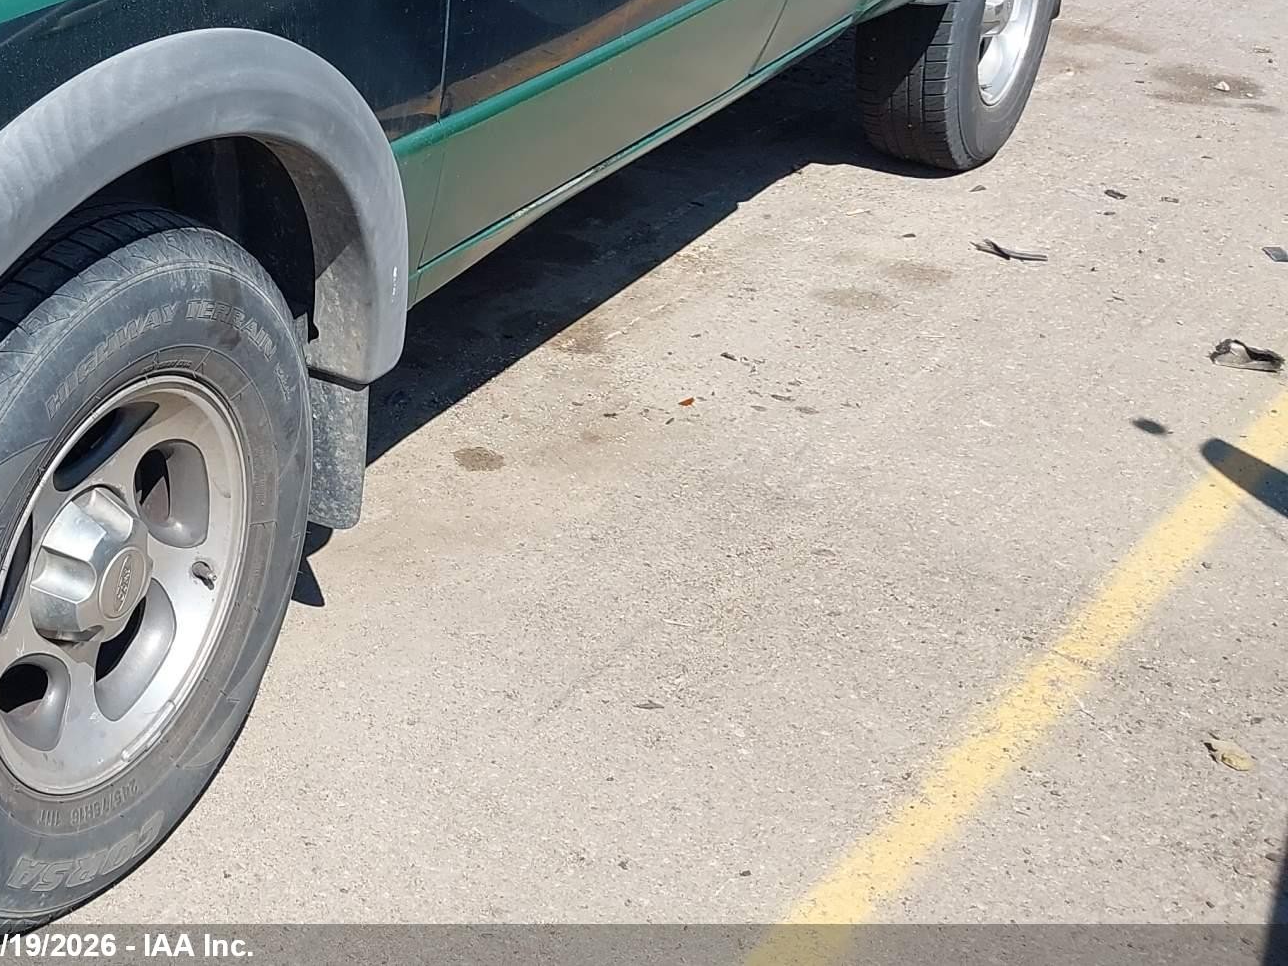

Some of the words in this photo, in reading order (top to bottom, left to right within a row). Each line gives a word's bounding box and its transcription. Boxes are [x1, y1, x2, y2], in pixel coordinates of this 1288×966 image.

[45, 301, 177, 420] HIGHWAY
[185, 299, 278, 361] TERRAIN
[8, 810, 165, 891] CORSA
